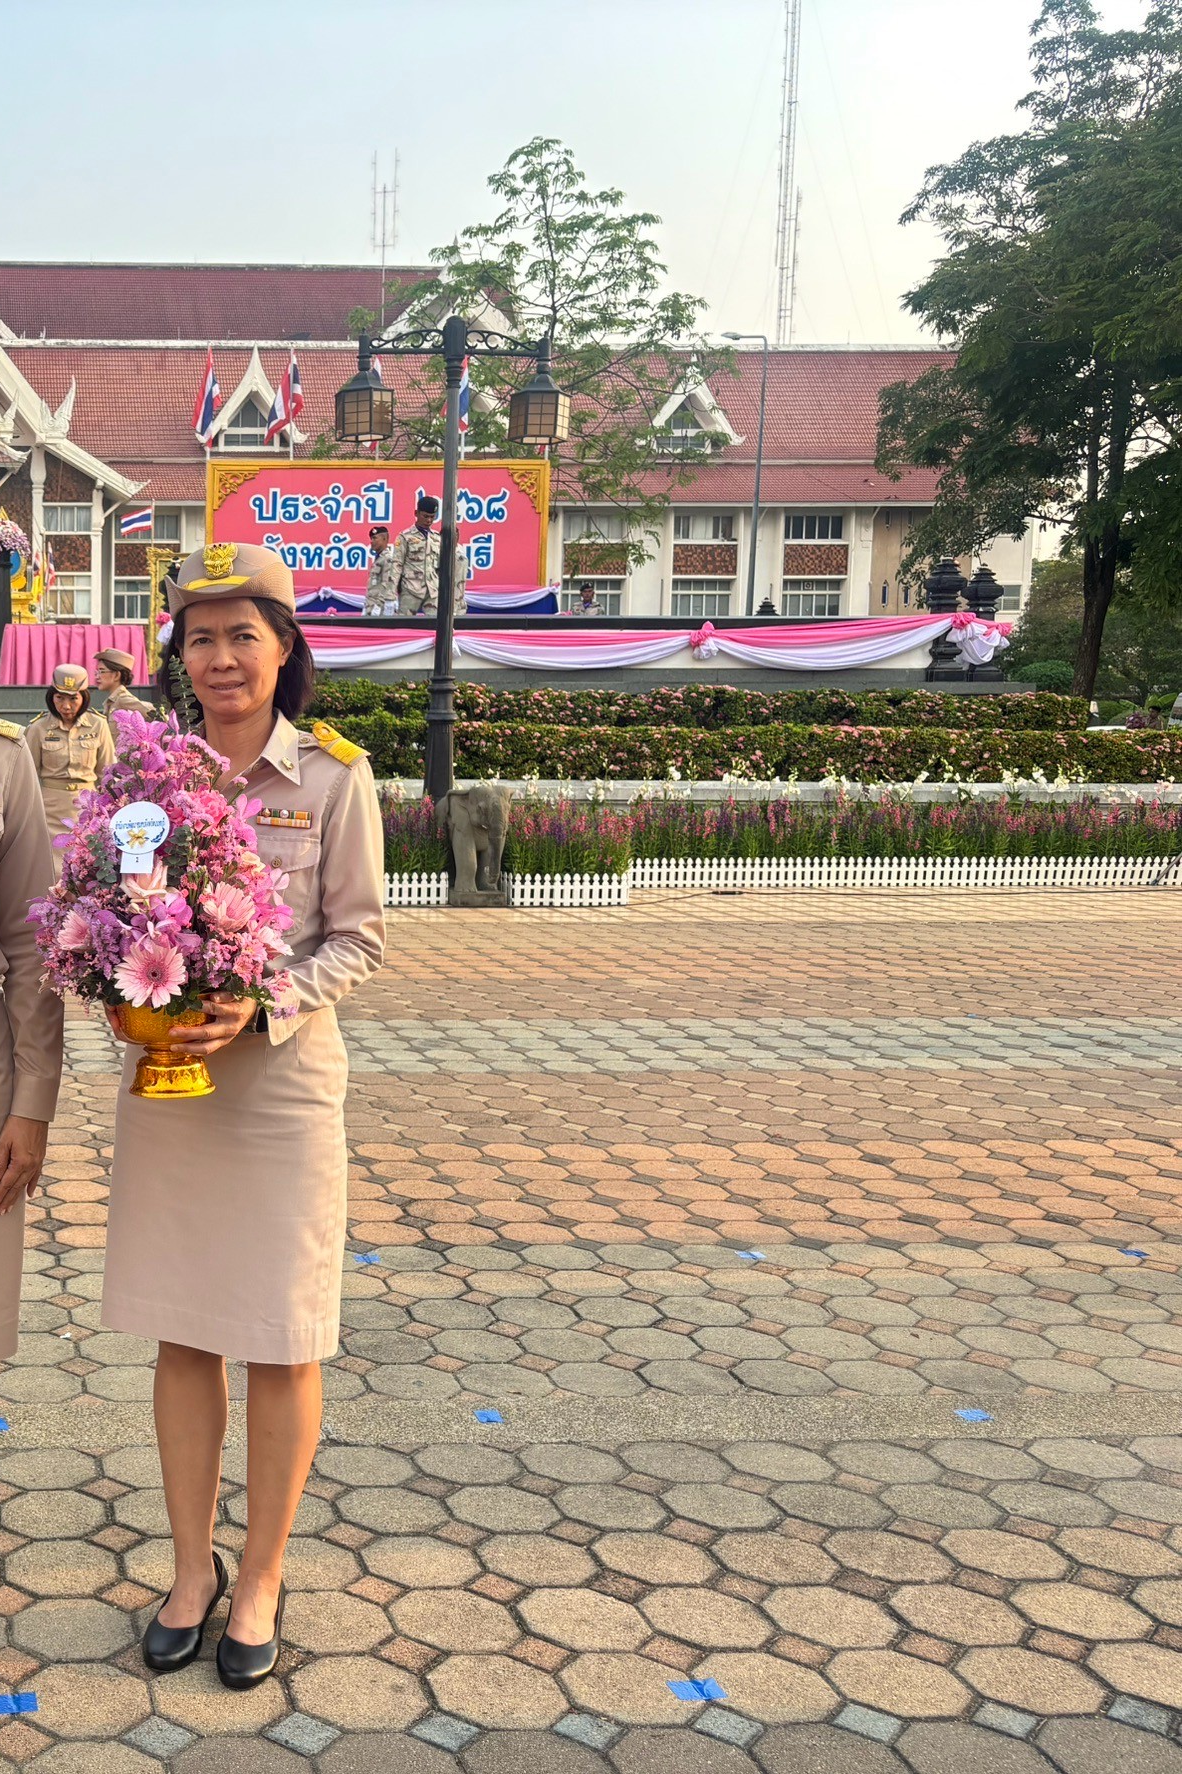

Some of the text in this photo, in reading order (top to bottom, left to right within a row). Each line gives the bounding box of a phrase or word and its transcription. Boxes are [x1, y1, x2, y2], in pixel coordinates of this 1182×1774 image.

[253, 482, 509, 522] ประจำปี ๖๘
